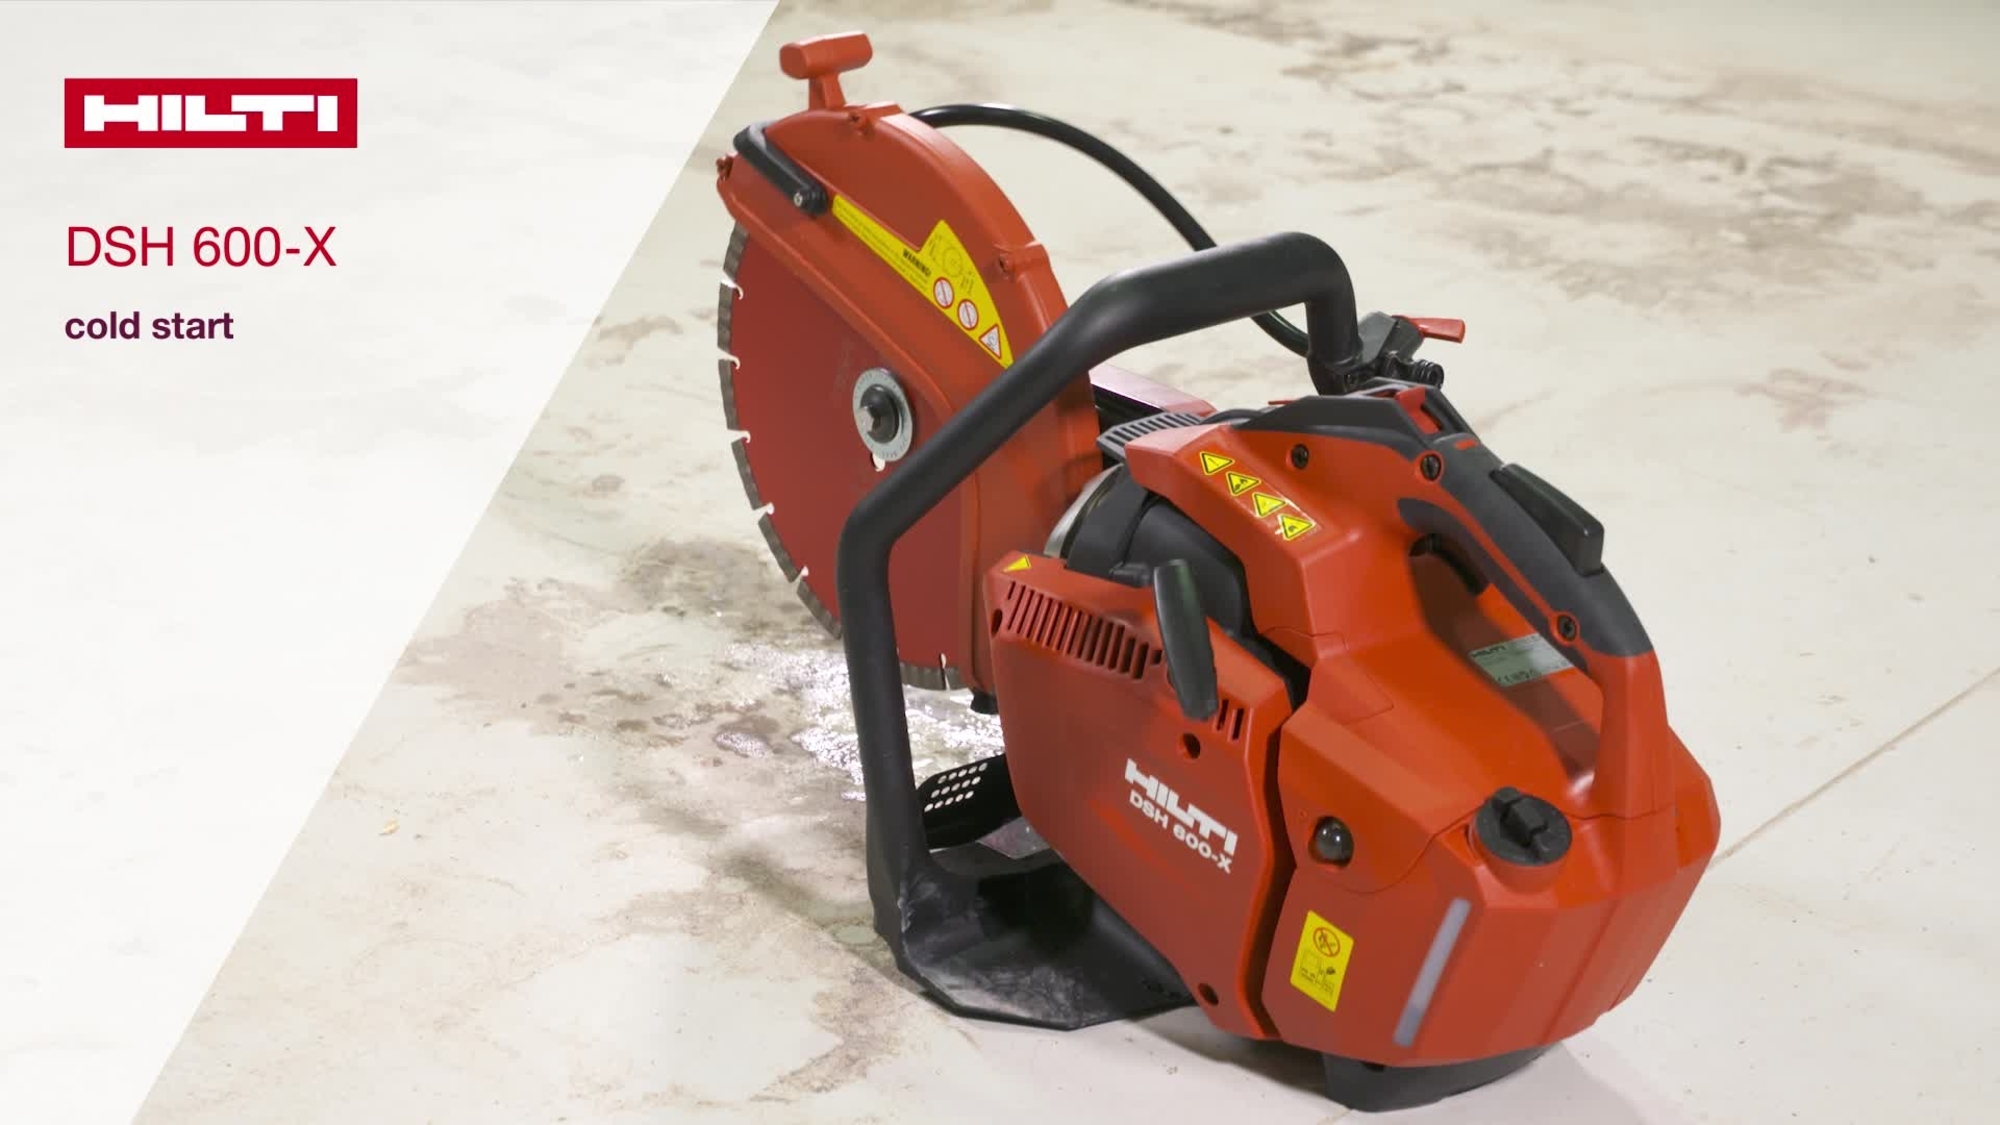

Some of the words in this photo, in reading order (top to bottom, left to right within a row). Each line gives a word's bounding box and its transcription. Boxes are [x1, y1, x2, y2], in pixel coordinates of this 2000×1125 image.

[1124, 758, 1239, 857] HILTI
[1129, 788, 1169, 829] DSH
[1172, 823, 1233, 874] 600-X
